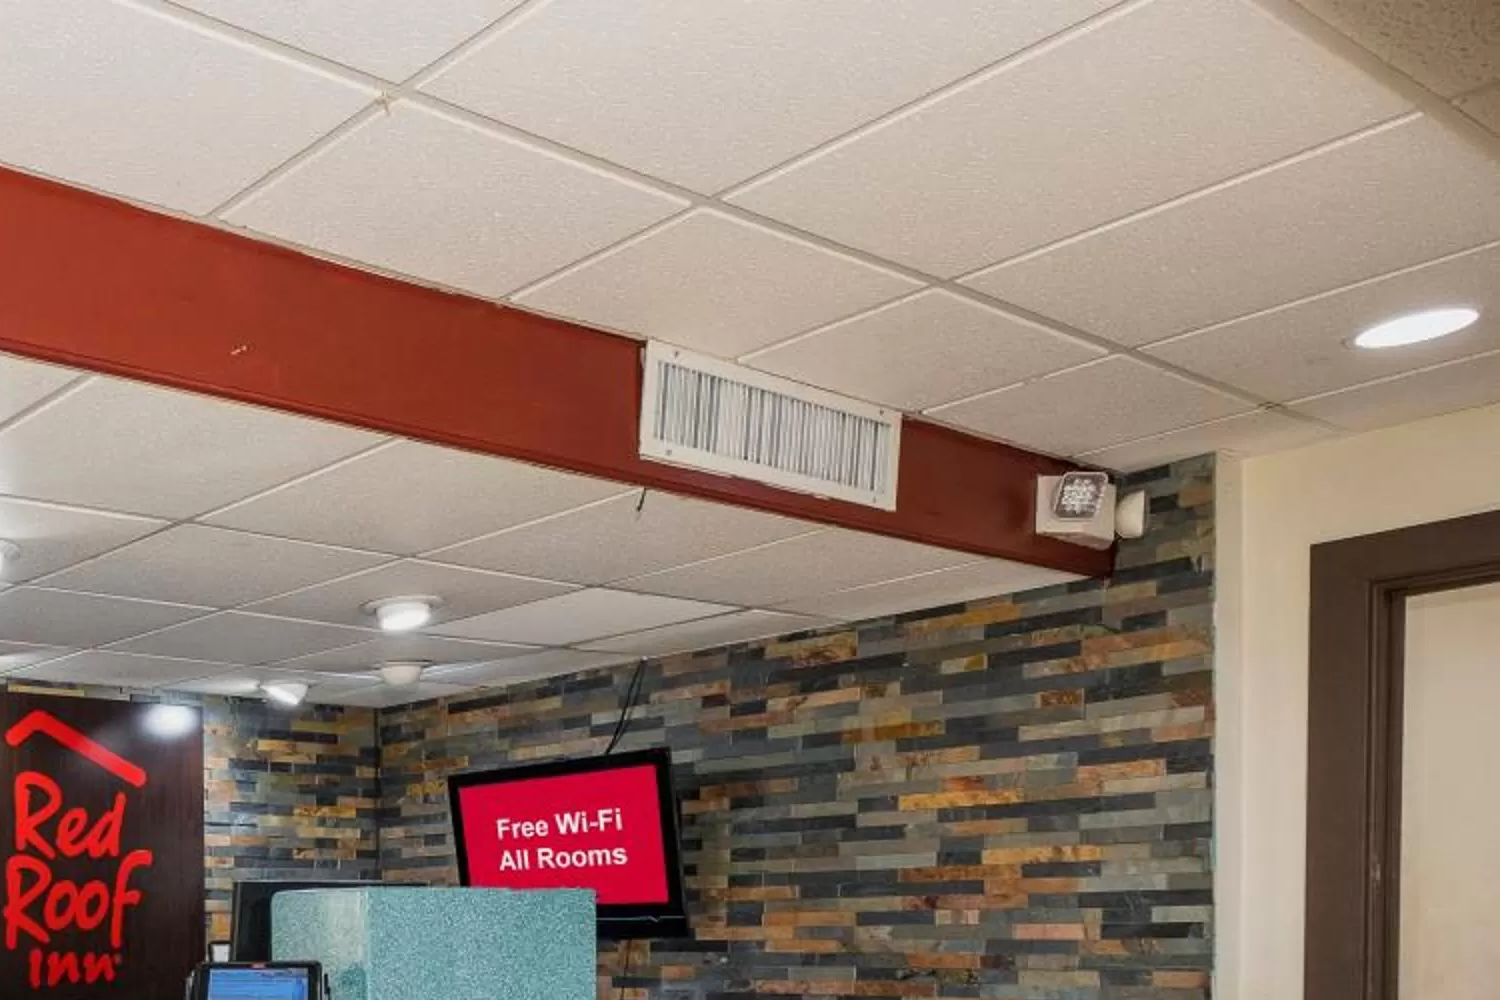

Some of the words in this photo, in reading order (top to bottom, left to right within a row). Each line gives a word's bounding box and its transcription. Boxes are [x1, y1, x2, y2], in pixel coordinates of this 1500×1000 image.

[13, 770, 127, 860] Red
[496, 817, 549, 840] Free
[554, 808, 623, 835] Wi-Fi
[499, 849, 530, 871] All
[537, 847, 628, 869] Rooms
[3, 849, 153, 950] Roof
